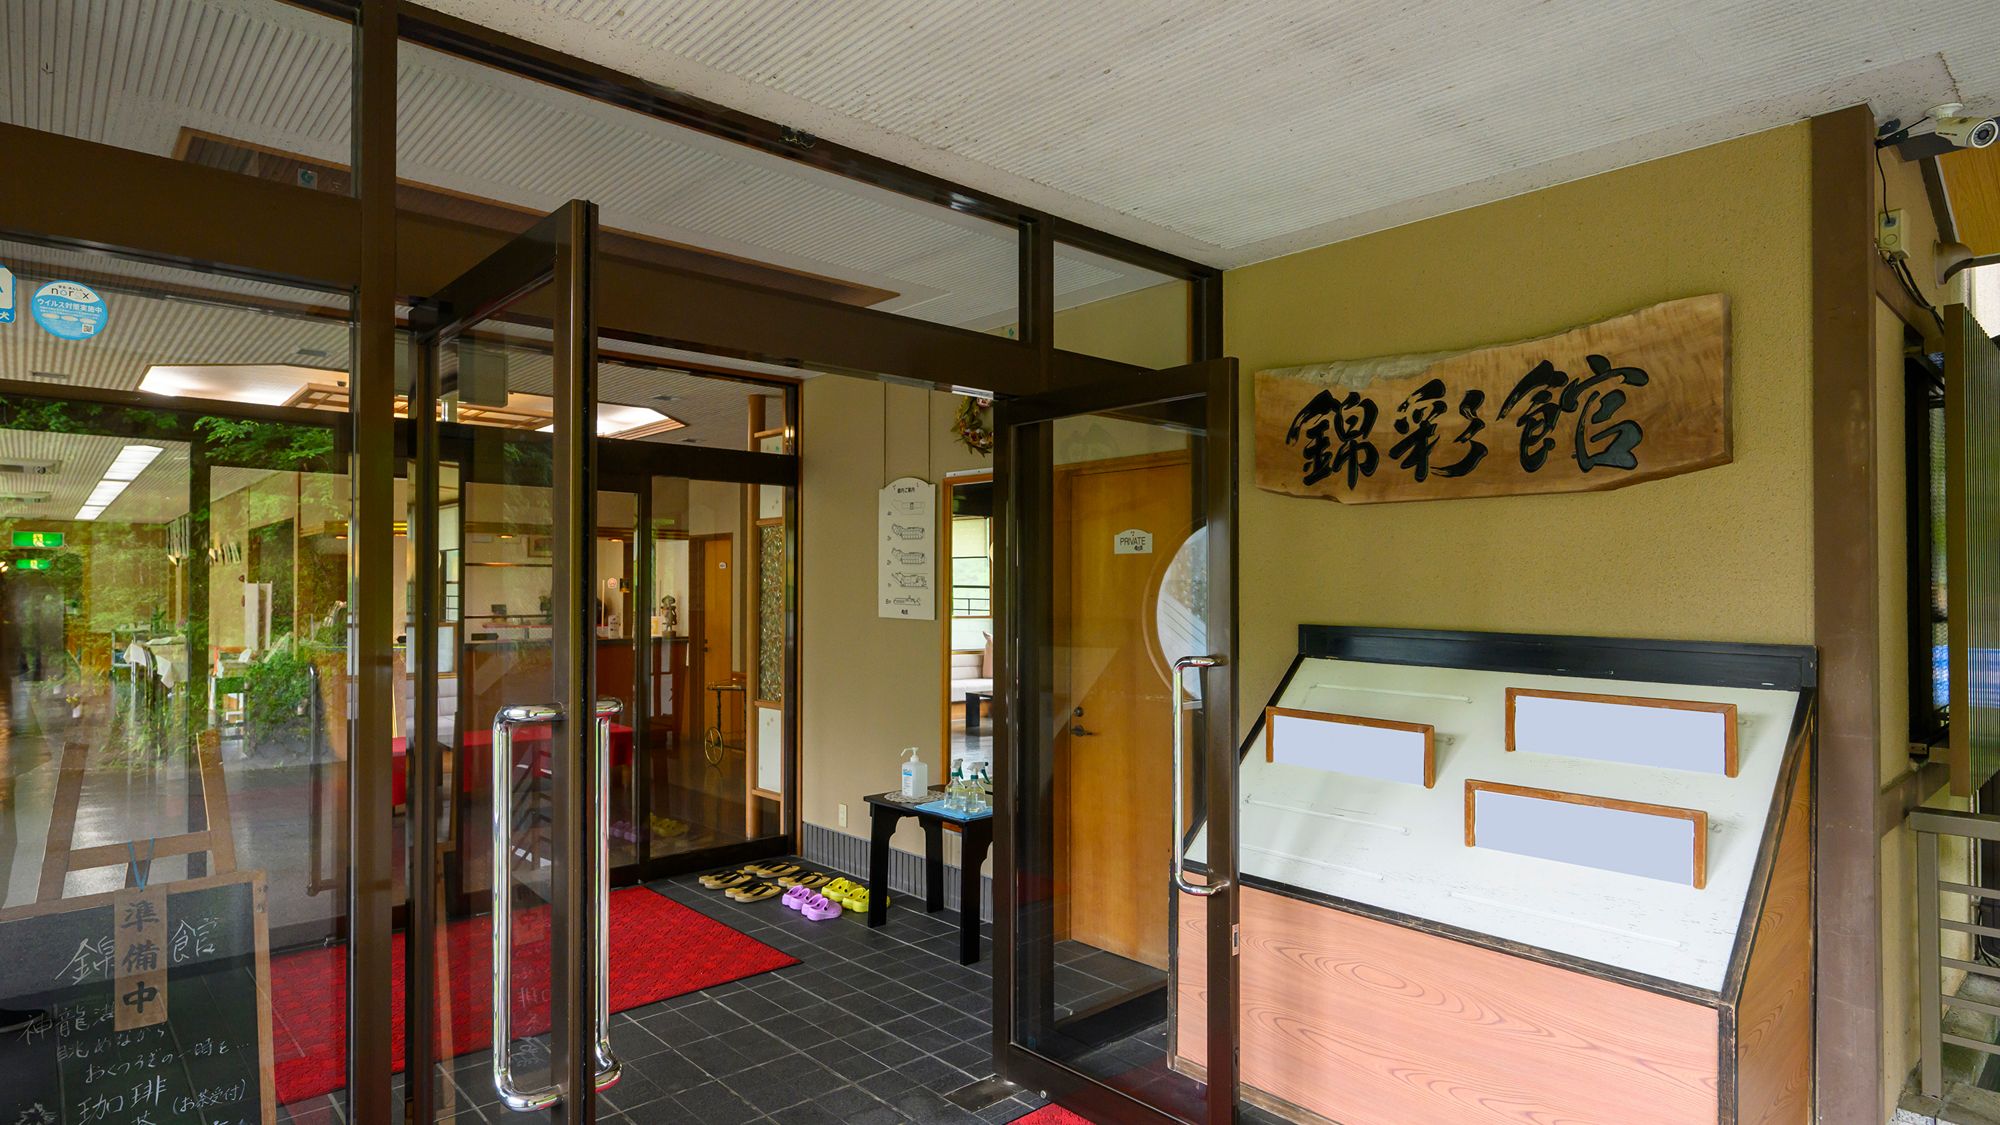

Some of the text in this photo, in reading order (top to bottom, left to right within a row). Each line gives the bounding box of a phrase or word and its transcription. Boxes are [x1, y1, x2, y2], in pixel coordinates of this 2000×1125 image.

[1286, 354, 1650, 490] 錦彩館
[1120, 536, 1146, 546] PRIVATE
[120, 901, 161, 1014] 準備中
[77, 1075, 168, 1125] 珈琲
